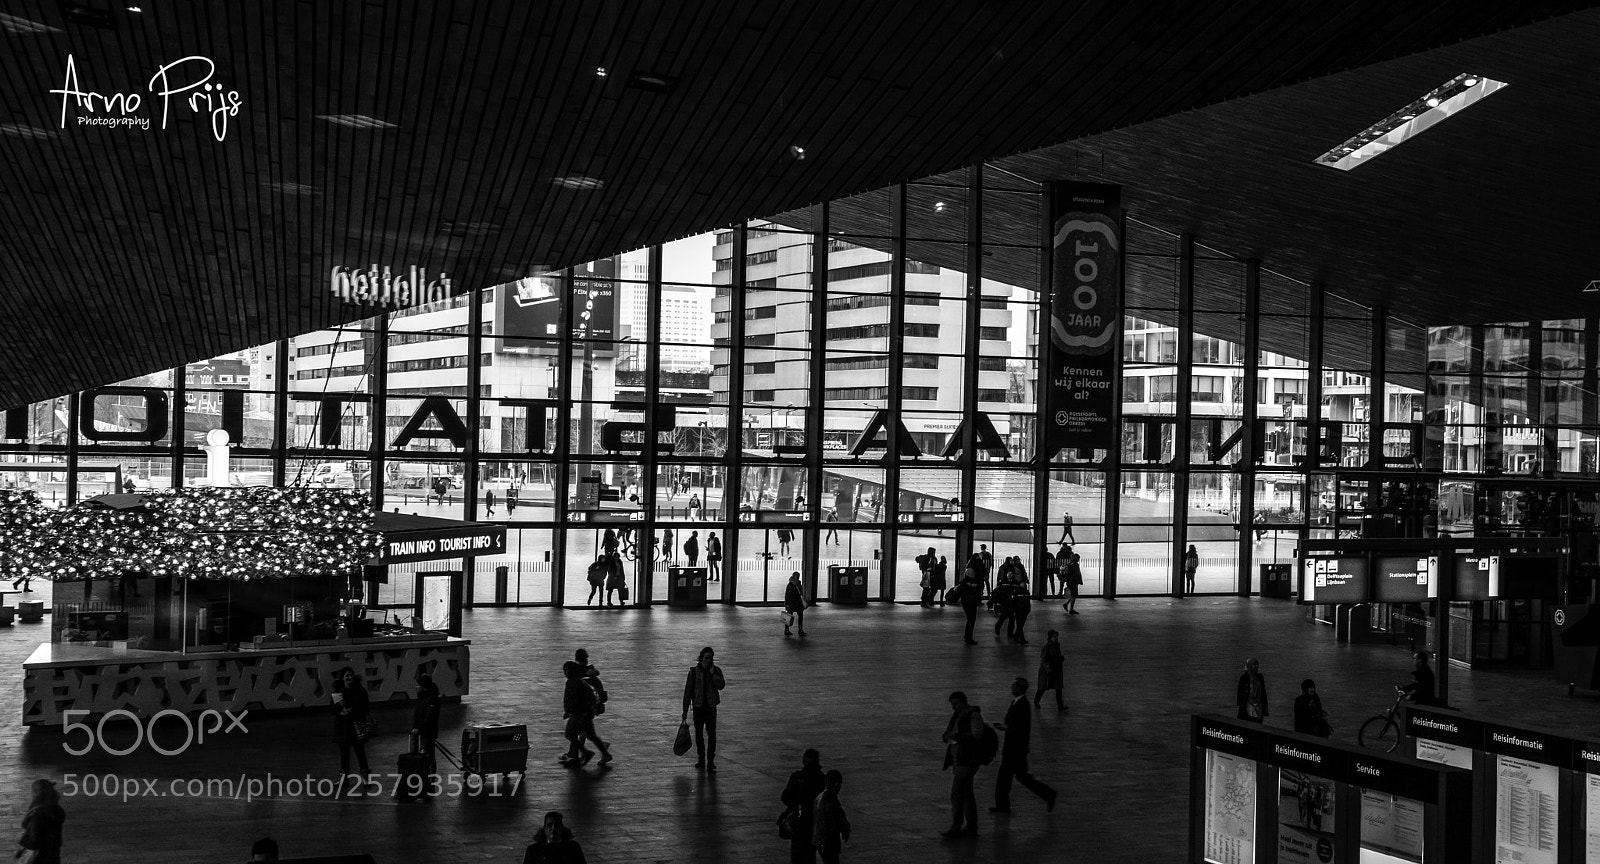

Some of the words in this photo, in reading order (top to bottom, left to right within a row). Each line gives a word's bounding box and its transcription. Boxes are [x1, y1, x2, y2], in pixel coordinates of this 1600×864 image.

[1074, 239, 1099, 310] 100
[1067, 313, 1102, 328] JAAR
[1063, 366, 1103, 376] Kennen
[1054, 377, 1073, 390] wij
[1075, 377, 1111, 389] elkaar
[1074, 390, 1091, 400] al?
[390, 542, 415, 556] TRAIN
[416, 539, 436, 554] INFO
[440, 536, 472, 552] TOURIST
[473, 535, 491, 548] INFO
[1412, 716, 1459, 733] Reisinformatie
[1202, 726, 1244, 744] Reisinformatie
[1492, 732, 1543, 751] Reisinformatie
[1275, 744, 1322, 763] Reisinformatie
[1356, 762, 1381, 777] Service
